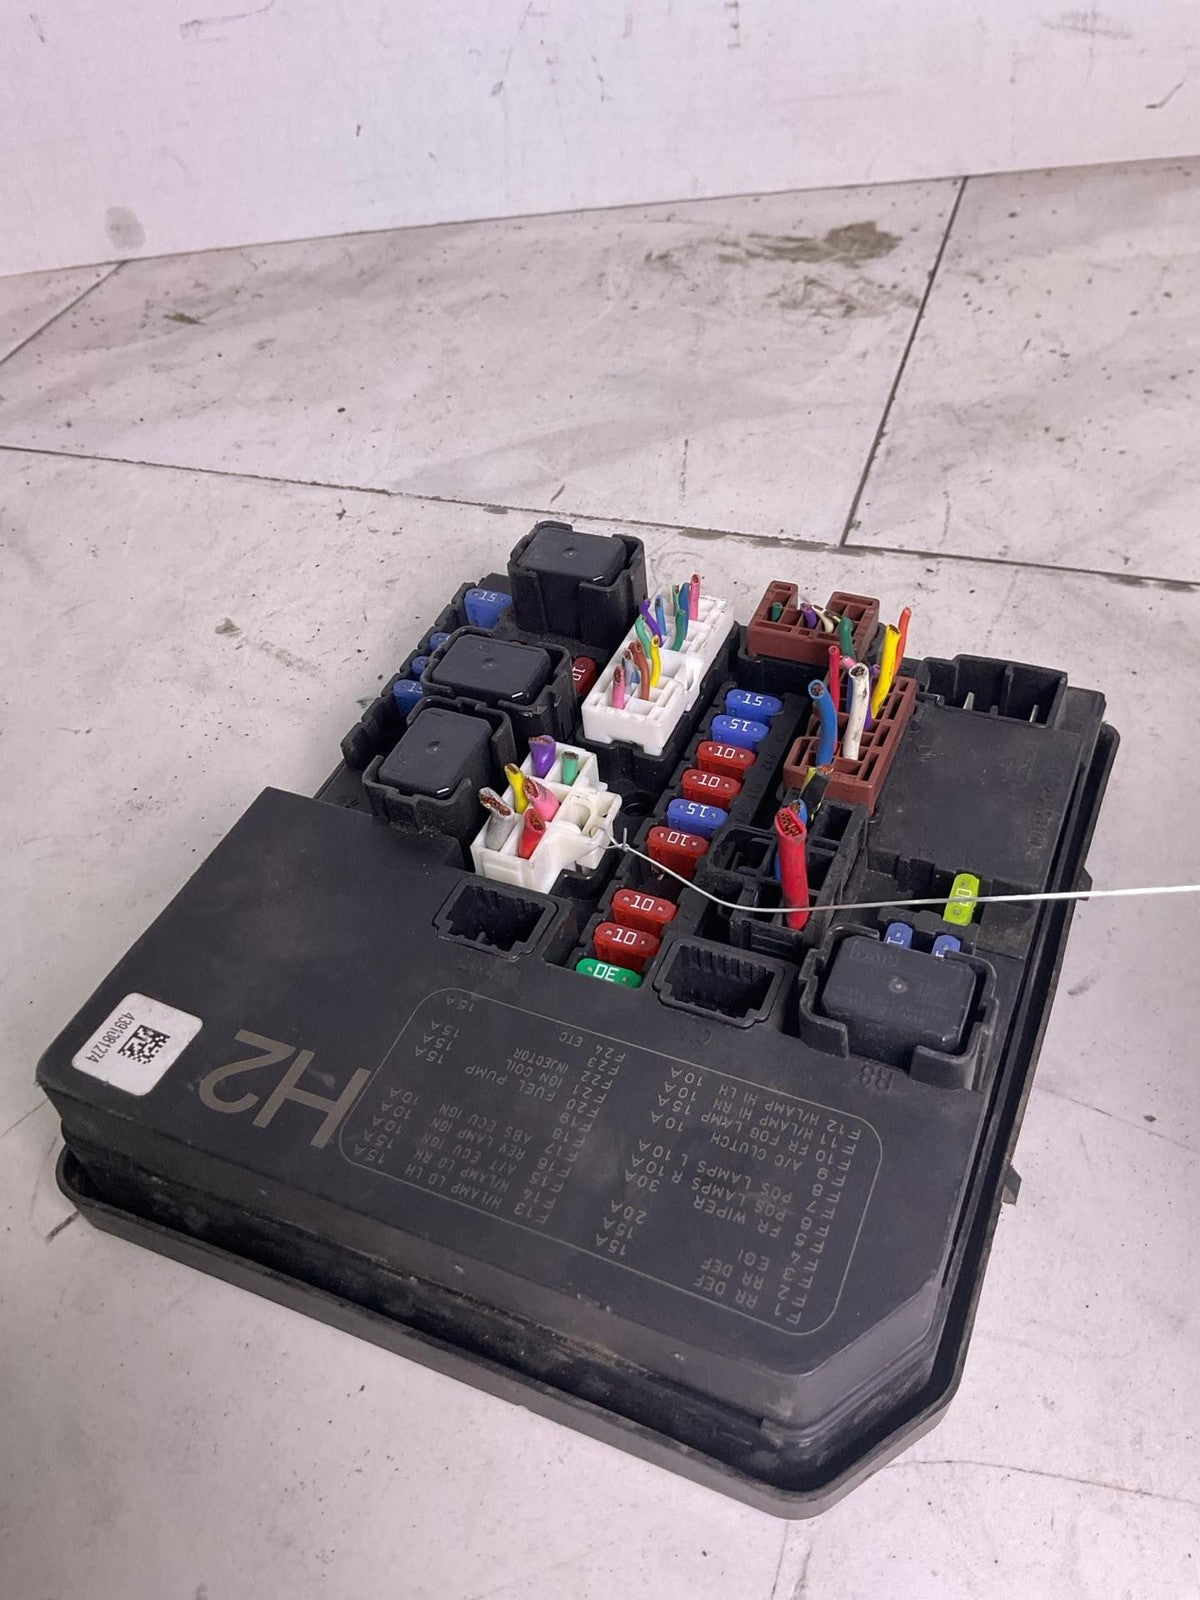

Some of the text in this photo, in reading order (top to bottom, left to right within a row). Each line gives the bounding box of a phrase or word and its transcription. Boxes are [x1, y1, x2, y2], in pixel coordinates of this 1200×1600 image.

[479, 591, 498, 602] 15
[742, 693, 764, 706] 15
[729, 718, 752, 732] 15
[713, 745, 736, 759] 10
[698, 774, 720, 788] 10
[686, 802, 709, 818] 15
[667, 831, 690, 847] 10
[630, 895, 654, 912] 10
[612, 928, 637, 946] 10
[593, 963, 620, 982] 30
[446, 996, 474, 1012] 15A
[431, 1020, 460, 1038] 15A
[423, 1033, 453, 1051] 15A
[559, 1032, 584, 1048] ETC
[415, 1046, 444, 1064] 15A
[513, 1048, 569, 1074] INJECTOR
[465, 1064, 508, 1086] PUMP
[507, 1059, 533, 1078] COIL
[671, 1066, 702, 1087] 10A
[199, 1029, 371, 1149] H2
[540, 1073, 563, 1088] IGN
[390, 1086, 420, 1105] 10A
[519, 1079, 557, 1102] FUEL
[665, 1081, 696, 1101] 10A
[718, 1084, 737, 1098] LH
[743, 1092, 758, 1106] HI
[381, 1101, 412, 1119] 10A
[439, 1104, 462, 1119] IGN
[659, 1095, 691, 1115] 15A
[713, 1098, 732, 1114] RH
[739, 1107, 753, 1120] HI
[765, 1101, 819, 1126] H/LAMP
[372, 1115, 403, 1135] 10A
[468, 1114, 498, 1132] ECU
[651, 1111, 683, 1132] 10A
[701, 1111, 742, 1133] LAMP
[760, 1116, 813, 1140] H/LAMP
[363, 1130, 394, 1149] 15A
[457, 1129, 494, 1148] LAMP
[503, 1126, 534, 1144] ABS
[750, 1127, 781, 1146] FOG
[355, 1144, 386, 1164] 15A
[453, 1144, 482, 1164] ECU
[498, 1143, 526, 1160] REV
[639, 1139, 671, 1161] 10A
[710, 1132, 766, 1160] CLUTCH
[788, 1139, 809, 1156] FR
[438, 1156, 456, 1173] LO
[489, 1160, 517, 1175] A/T
[632, 1154, 664, 1176] 10A
[682, 1153, 688, 1167] L
[774, 1154, 803, 1171] A/C
[404, 1163, 423, 1178] LH
[672, 1170, 683, 1183] R
[697, 1160, 752, 1189] LAMPS
[428, 1172, 447, 1189] LO
[460, 1168, 510, 1193] H/LAMP
[625, 1169, 660, 1192] 30A
[451, 1183, 501, 1211] H/LAMP
[691, 1178, 746, 1207] LAMPS
[761, 1183, 792, 1203] POS
[611, 1200, 647, 1224] 20A
[693, 1195, 746, 1225] WIPER
[755, 1200, 787, 1221] POS
[603, 1217, 634, 1239] 15A
[757, 1219, 781, 1238] FR
[596, 1233, 626, 1256] 15A
[701, 1258, 733, 1278] DEF
[693, 1275, 726, 1296] DEF
[742, 1270, 764, 1290] RR
[735, 1289, 758, 1308] RR
